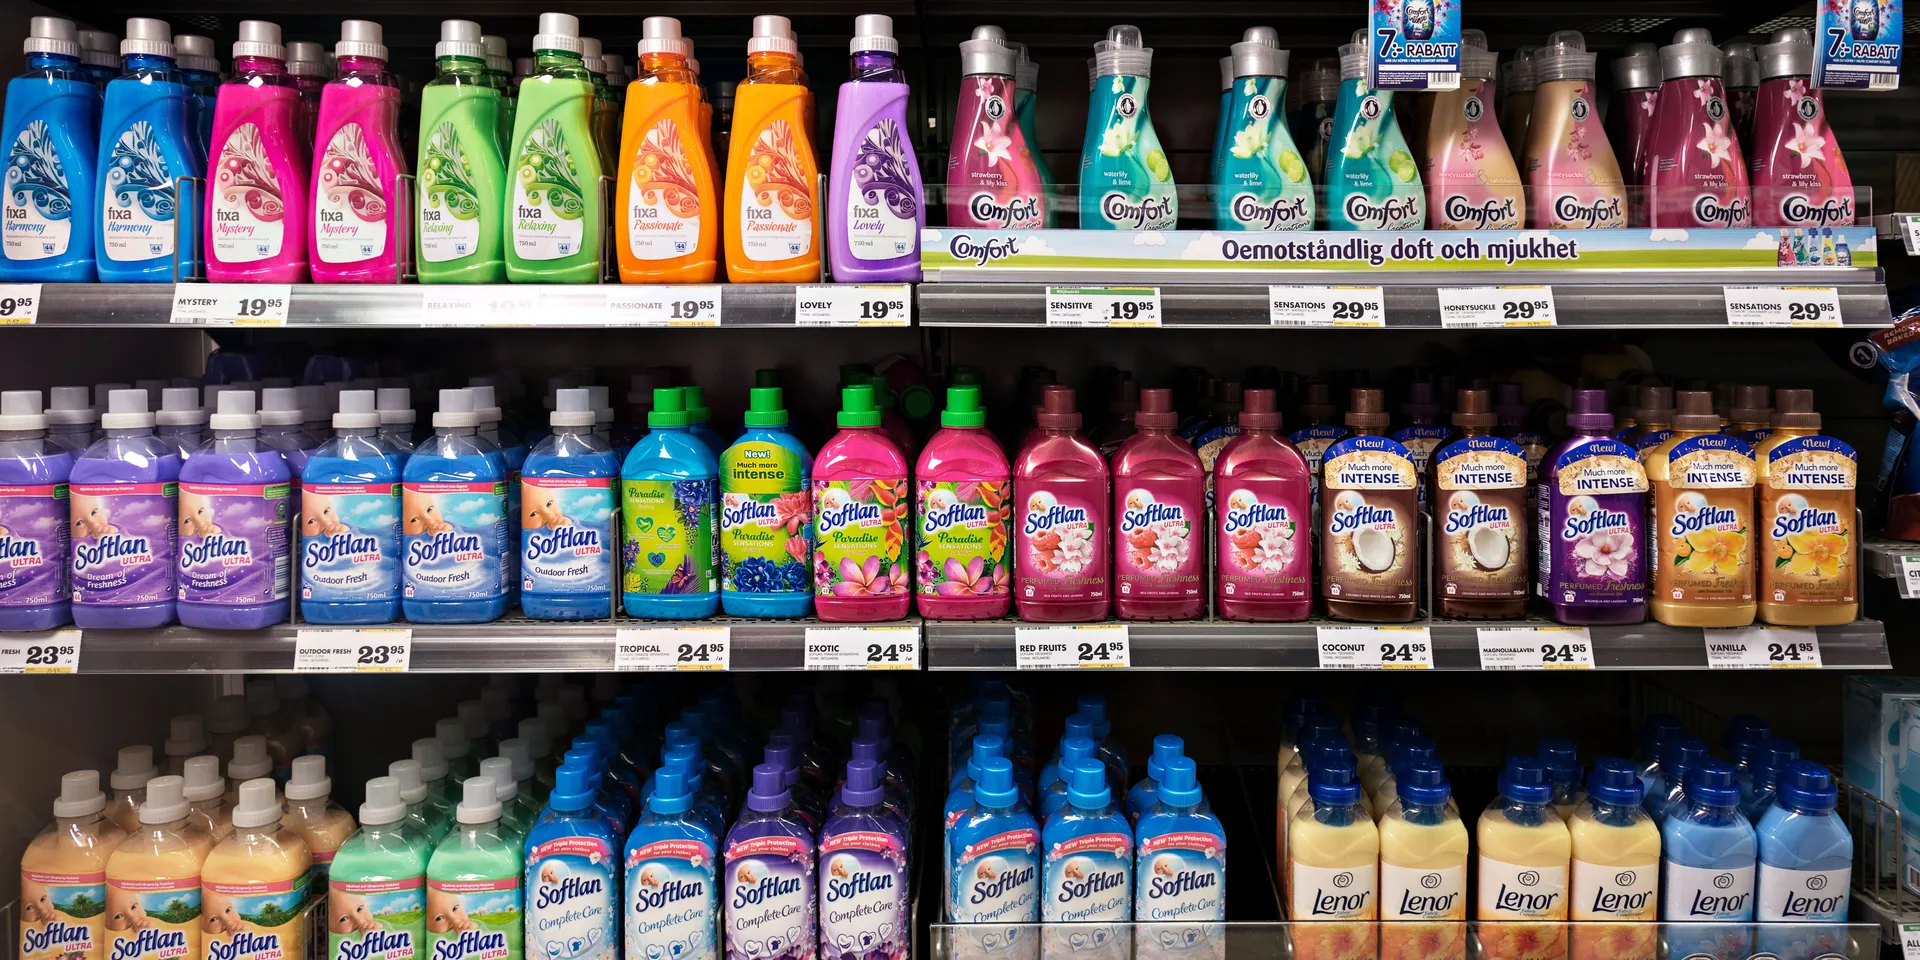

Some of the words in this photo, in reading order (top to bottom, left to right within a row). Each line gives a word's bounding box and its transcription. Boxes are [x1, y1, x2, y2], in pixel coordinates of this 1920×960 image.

[1407, 44, 1456, 56] RABATT
[1854, 45, 1898, 58] RABATT
[1235, 172, 1259, 180] waterlily
[6, 206, 27, 219] fixa
[108, 207, 131, 220] fixa
[217, 209, 240, 221] fixa
[321, 209, 343, 221] fixa
[423, 209, 440, 220] fixa
[518, 206, 541, 218] fixa
[634, 206, 657, 218] fixa
[747, 206, 772, 219] fixa
[854, 206, 879, 218] fixa
[972, 195, 1038, 229] Comfort
[1104, 194, 1172, 228] Comfort
[1234, 196, 1307, 229] Comfort
[1347, 196, 1418, 229] Comfort
[1445, 196, 1515, 229] Comfort
[1556, 196, 1621, 229] Comfort
[1695, 196, 1750, 228] Comfort
[1783, 196, 1852, 225] Comfort
[6, 221, 46, 234] Harmony
[108, 221, 153, 234] Harmony
[217, 223, 255, 237] Mystery
[320, 223, 358, 237] Mystery
[423, 222, 453, 234] Relaxing
[518, 219, 556, 234] Relaxing
[634, 220, 683, 232] Passionate
[747, 221, 797, 233] Passionate
[853, 221, 885, 234] Lovely
[950, 235, 1019, 266] Comfort
[1223, 240, 1384, 265] Oemotståndlig
[1391, 238, 1434, 259] doft
[1441, 238, 1479, 258] och
[1487, 238, 1578, 264] mjukhet
[1356, 440, 1384, 449] New!
[1698, 438, 1727, 447] New!
[734, 469, 784, 479] intense
[1341, 474, 1400, 484] INTENSE
[1455, 473, 1512, 484] INTENSE
[1577, 478, 1634, 489] INTENSE
[1688, 473, 1742, 483] INTENSE
[1788, 474, 1845, 484] INTENSE
[629, 488, 665, 498] Paradise
[723, 502, 776, 528] Softlan
[820, 503, 880, 532] Softlan
[925, 504, 985, 532] Softlan
[967, 520, 987, 528] ULTRA
[1025, 506, 1085, 534] Softlan
[1122, 504, 1182, 531] Softlan
[1225, 505, 1286, 531] Softlan
[1331, 506, 1393, 533] Softlan
[1446, 505, 1507, 532] Softlan
[1564, 511, 1627, 539] Softlan
[1672, 507, 1736, 536] Softlan
[1773, 509, 1837, 538] Softlan
[528, 527, 597, 560] Softlan
[733, 529, 774, 541] Paradise
[75, 535, 148, 570] Softlan
[123, 555, 151, 565] ULTRA
[182, 535, 248, 568] Softlan
[306, 534, 377, 567] Softlan
[409, 532, 480, 566] Softlan
[457, 553, 482, 561] ULTRA
[118, 567, 127, 578] of
[314, 575, 344, 584] Outdoor
[346, 572, 367, 583] Fresh
[535, 567, 565, 576] Outdoor
[567, 565, 588, 575] Fresh
[88, 578, 126, 588] Freshness
[1605, 580, 1644, 591] Freshness
[1153, 838, 1166, 846] NEW
[537, 877, 602, 909] Softlan
[636, 880, 703, 912] Softlan
[733, 876, 801, 909] Softlan
[827, 872, 893, 902] Softlan
[971, 866, 1034, 904] Softlan
[1059, 871, 1125, 903] Softlan
[1149, 871, 1216, 898] Softlan
[1152, 904, 1197, 919] Complete
[1197, 898, 1216, 911] Care
[1312, 889, 1370, 915] Lenor
[1400, 889, 1458, 915] Lenor
[1496, 883, 1558, 911] Lenor
[1592, 886, 1652, 912] Lenor
[1690, 889, 1749, 915] Lenor
[1782, 891, 1843, 917] Lenor
[539, 911, 581, 931] Complete
[582, 906, 602, 918] Care
[829, 907, 872, 924] Complete
[873, 900, 893, 912] Care
[24, 923, 89, 953] Softlan
[65, 942, 92, 951] ULTRA
[112, 929, 185, 960] Softlan
[434, 930, 504, 960] Softlan
[482, 949, 507, 959] ULTRA
